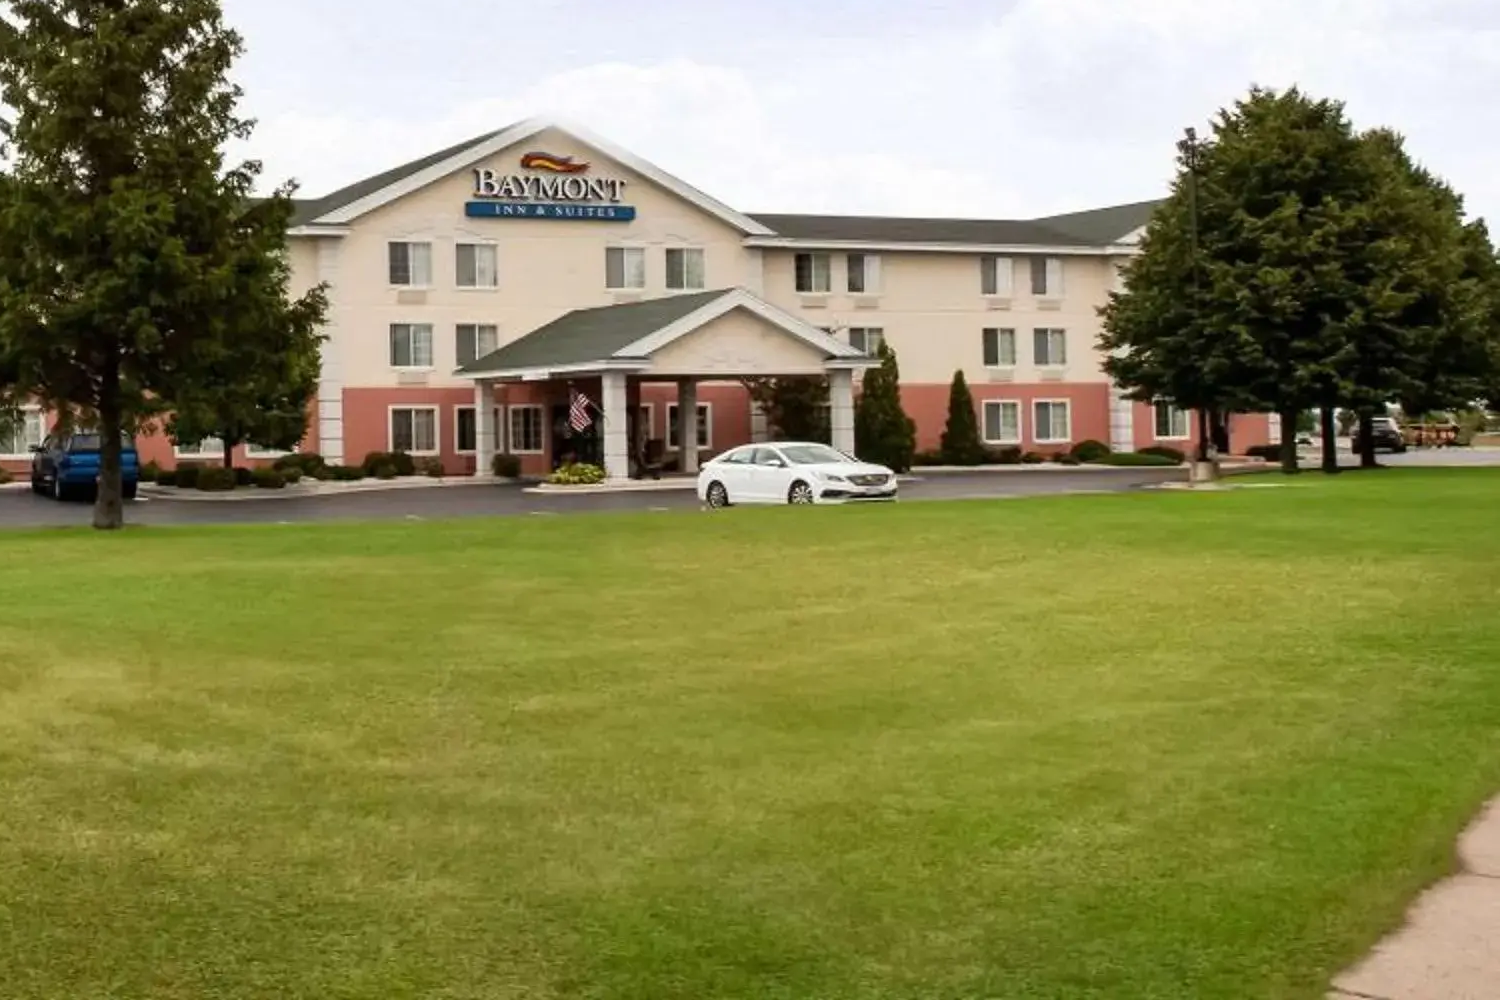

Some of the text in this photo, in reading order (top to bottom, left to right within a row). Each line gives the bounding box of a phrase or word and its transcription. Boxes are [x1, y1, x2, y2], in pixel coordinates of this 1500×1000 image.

[474, 168, 627, 201] BAYMONT
[494, 203, 526, 215] INN
[555, 207, 615, 217] SUITES
